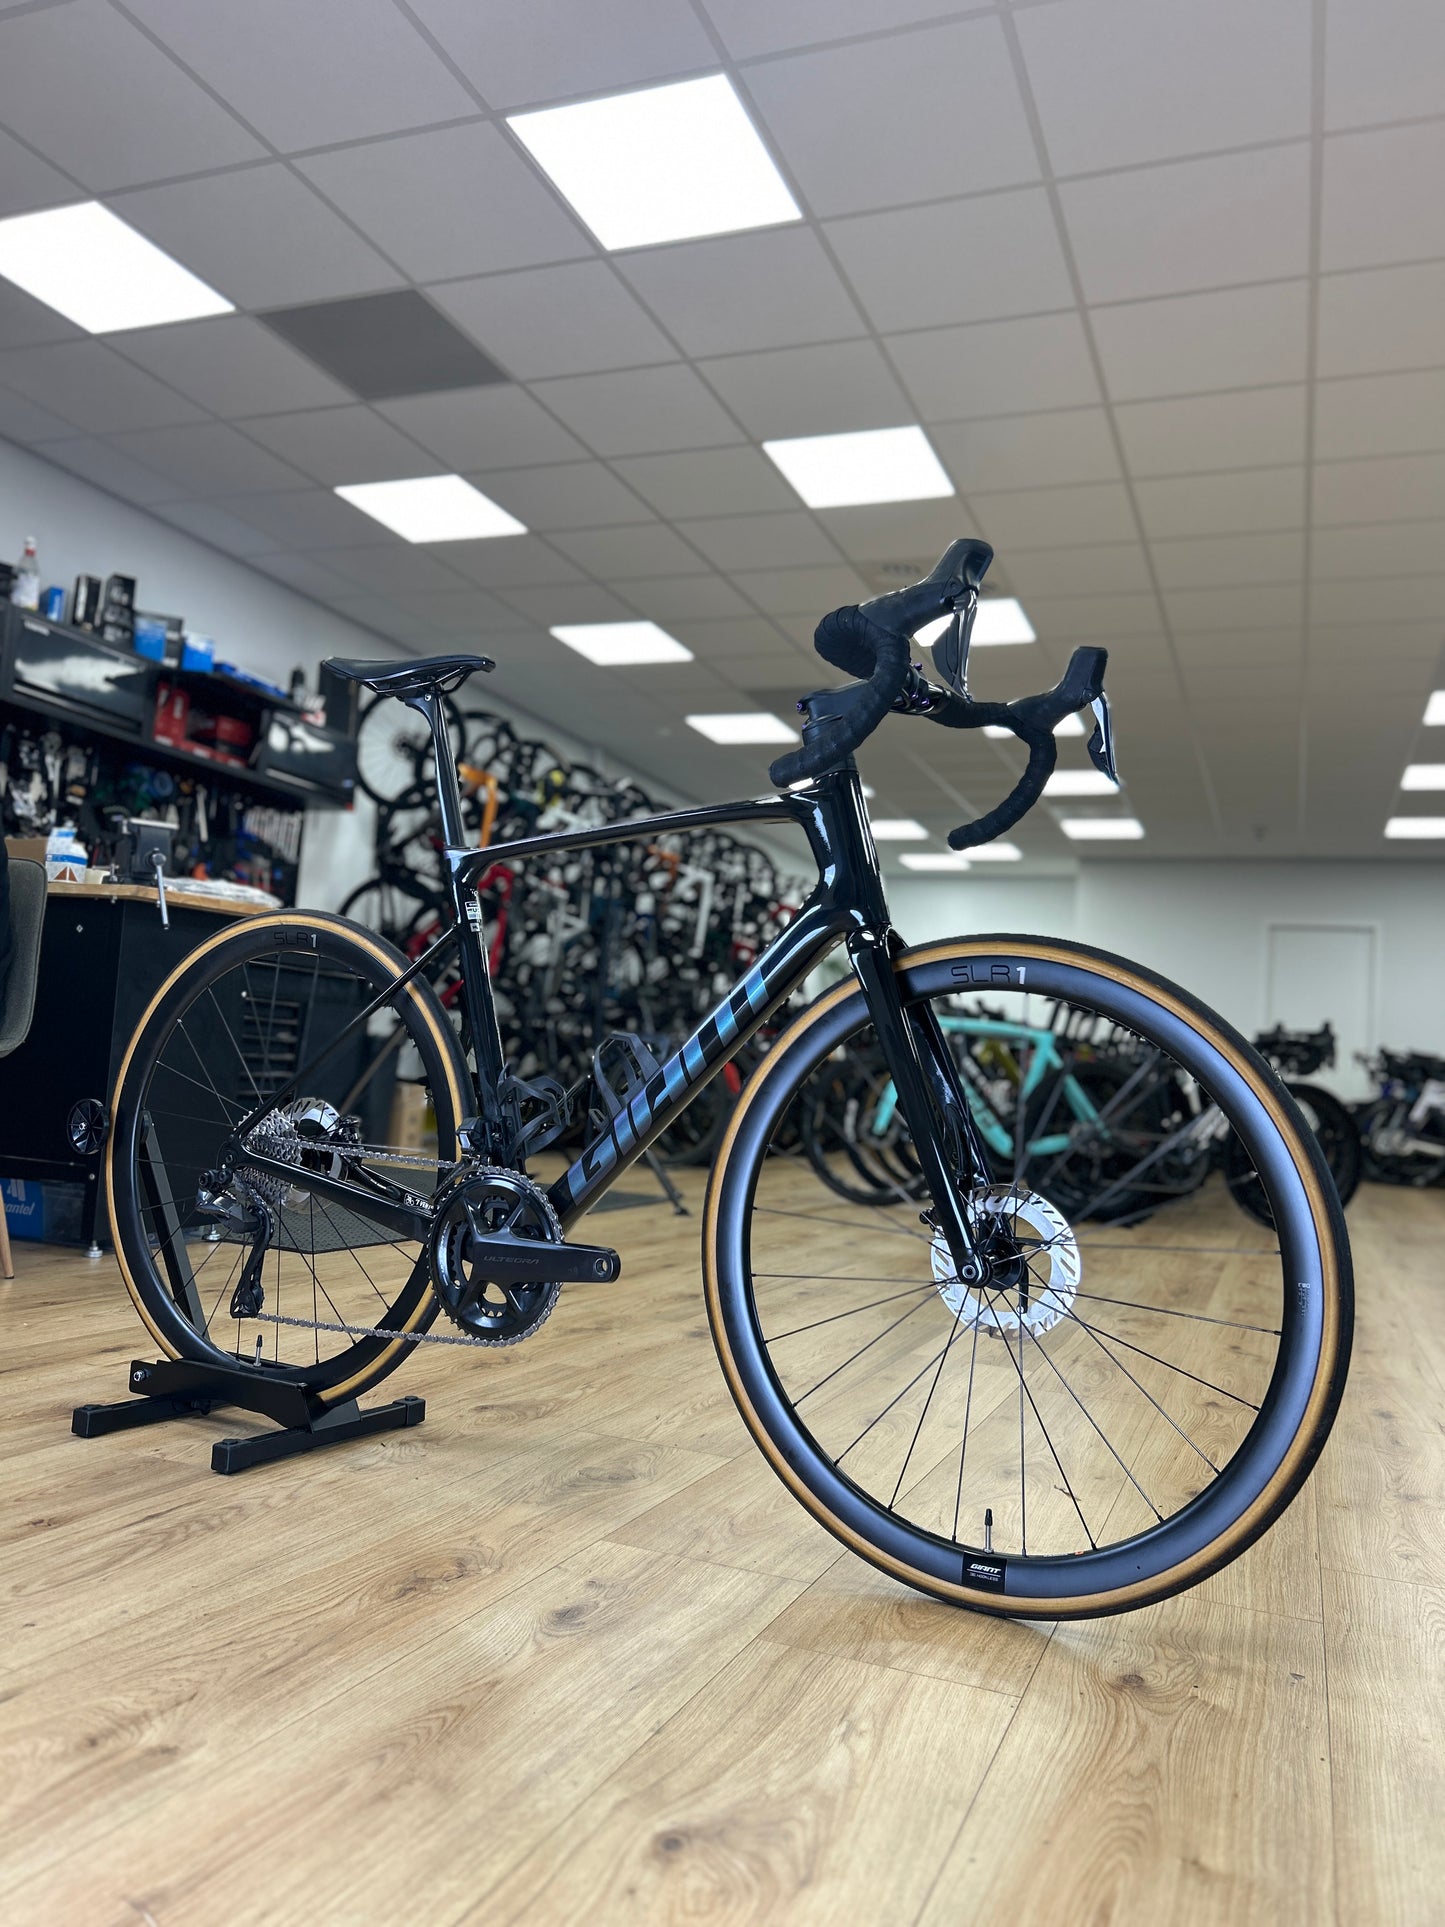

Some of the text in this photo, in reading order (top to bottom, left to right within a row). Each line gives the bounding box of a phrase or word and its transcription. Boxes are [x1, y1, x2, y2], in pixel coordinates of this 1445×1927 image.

[566, 955, 772, 1205] GIANT
[4, 1201, 36, 1216] antel
[970, 1563, 1002, 1573] GIANT
